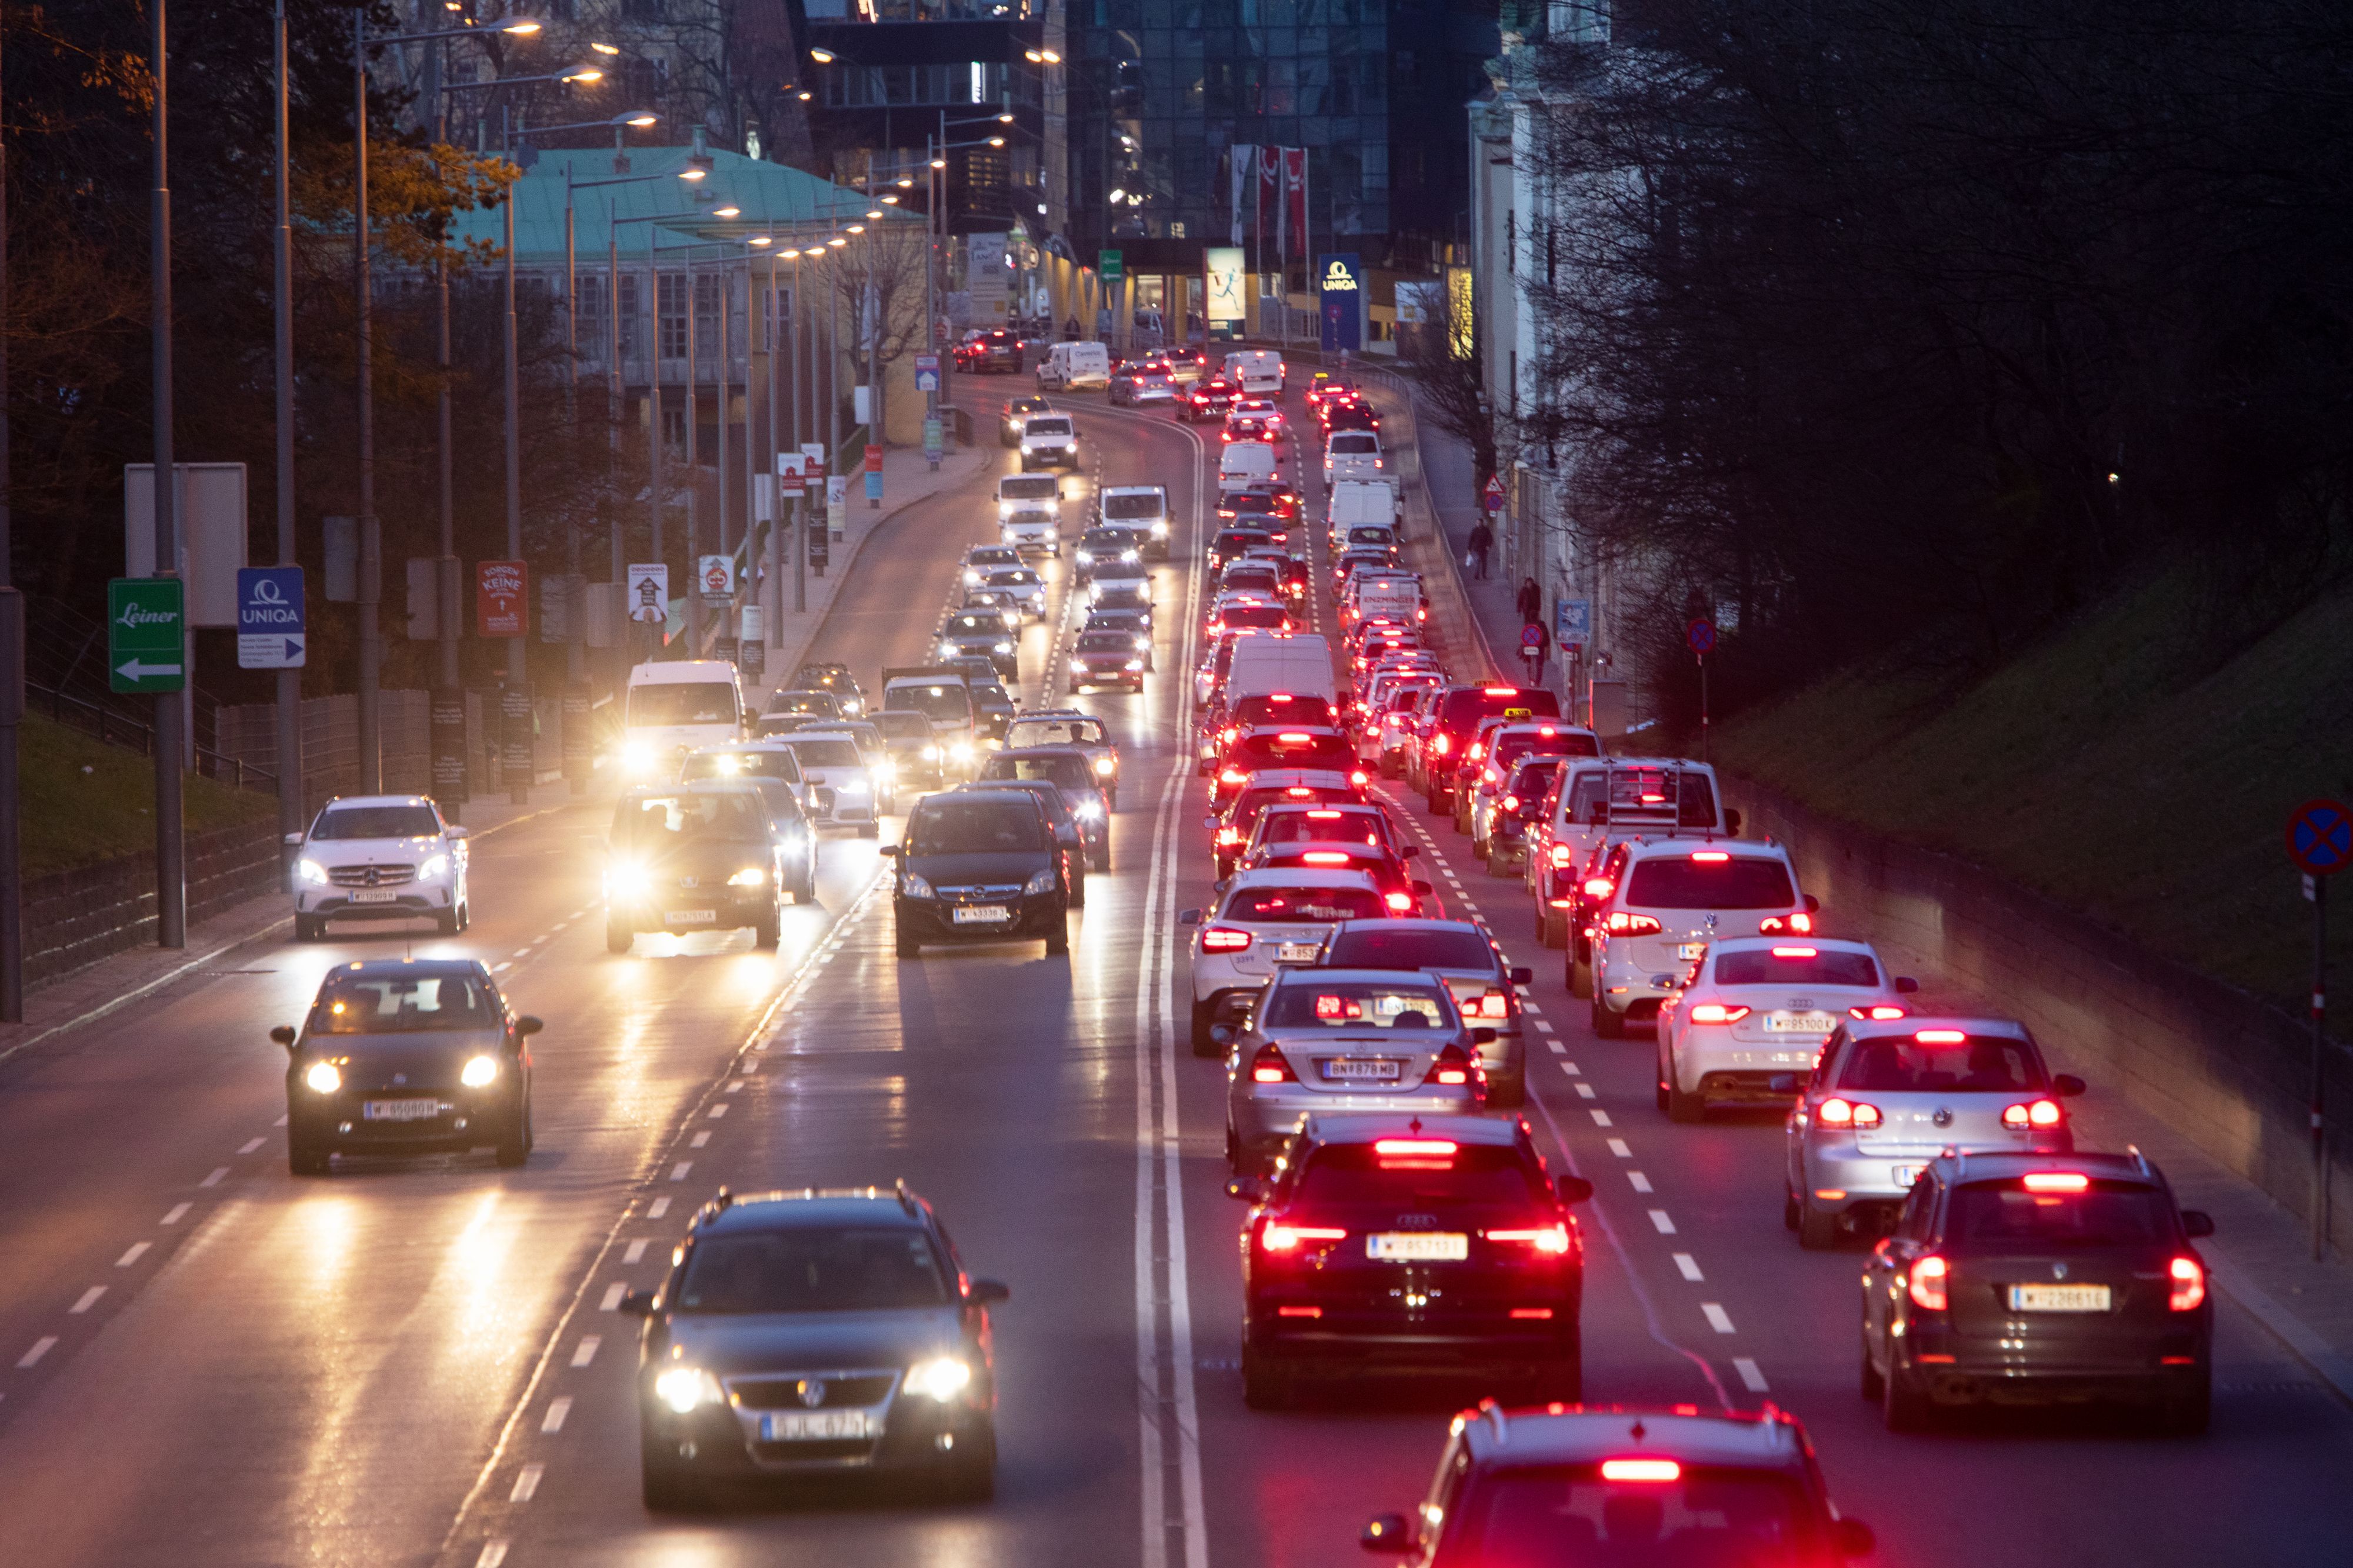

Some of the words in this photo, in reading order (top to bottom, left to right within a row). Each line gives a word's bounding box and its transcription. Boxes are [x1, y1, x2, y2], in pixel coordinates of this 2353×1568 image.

[1322, 279, 1358, 291] UNIQA
[482, 578, 522, 591] KEINE
[116, 602, 177, 629] Leiner
[242, 609, 298, 623] UNIQA
